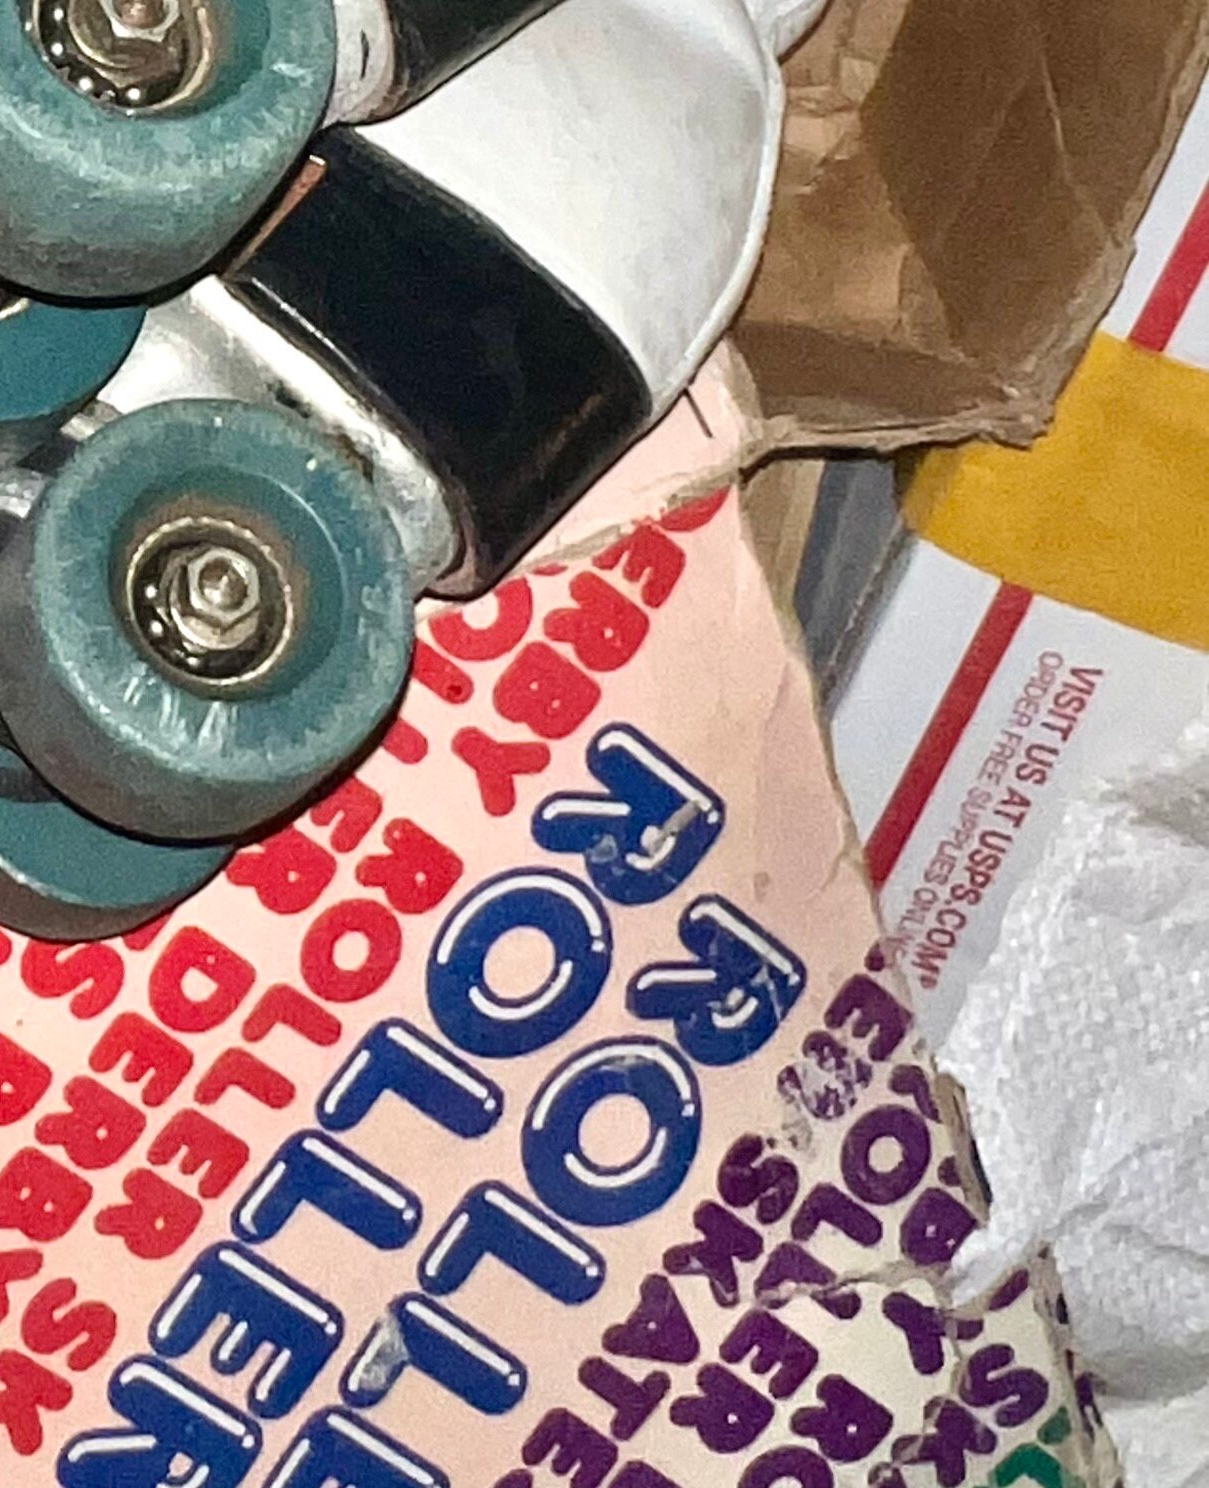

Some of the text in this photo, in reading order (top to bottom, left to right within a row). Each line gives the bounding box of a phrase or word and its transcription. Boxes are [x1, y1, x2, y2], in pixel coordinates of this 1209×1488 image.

[1008, 651, 1064, 728] ORDER
[1040, 665, 1103, 742] VISIT
[976, 728, 1023, 787] FREE
[1015, 742, 1060, 786] US
[924, 786, 992, 886] SUPPLIES
[993, 786, 1031, 829] AT
[96, 819, 464, 1260] ROLLER
[58, 723, 725, 1488] ROLLER
[495, 1136, 798, 1488] SKATE
[868, 1345, 1048, 1488] SK
